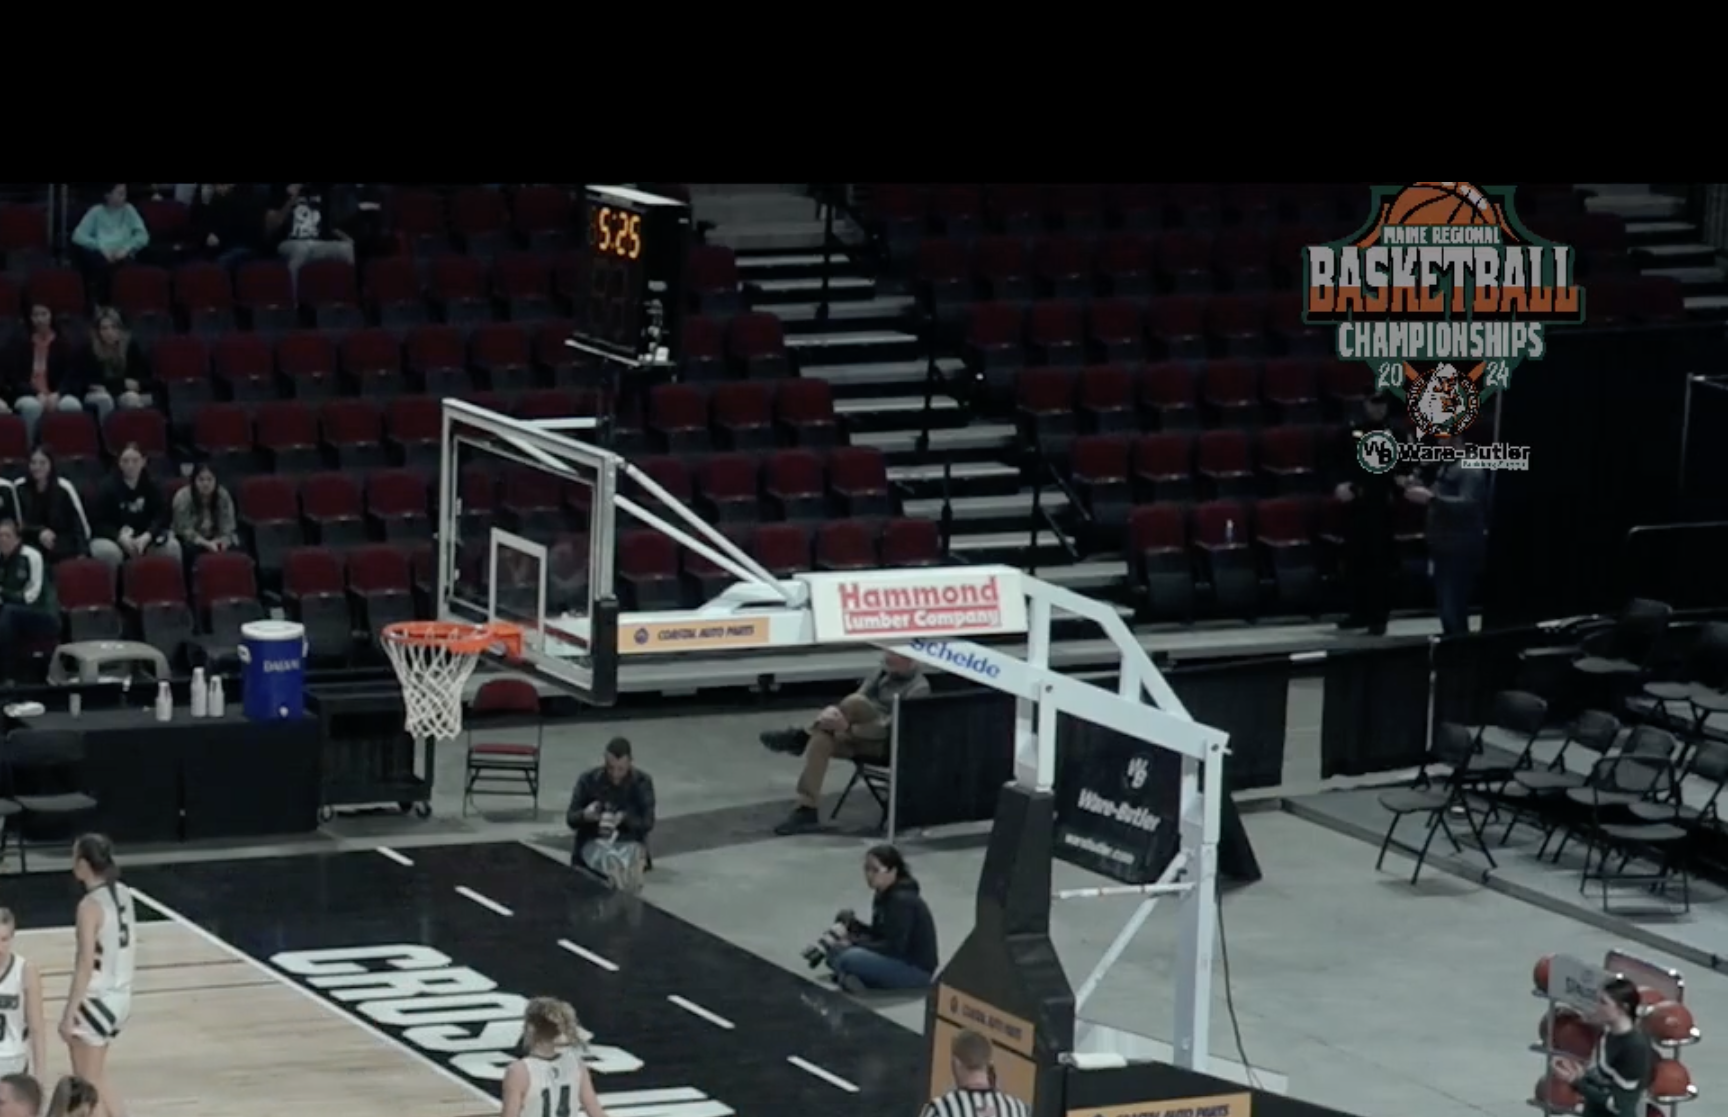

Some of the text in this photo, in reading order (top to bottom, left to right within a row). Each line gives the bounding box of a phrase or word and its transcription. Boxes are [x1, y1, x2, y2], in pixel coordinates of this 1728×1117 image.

[838, 576, 1000, 609] Hammond
[844, 610, 1000, 630] Lumber Company
[698, 626, 725, 638] AUTO
[727, 625, 755, 637] PARTS
